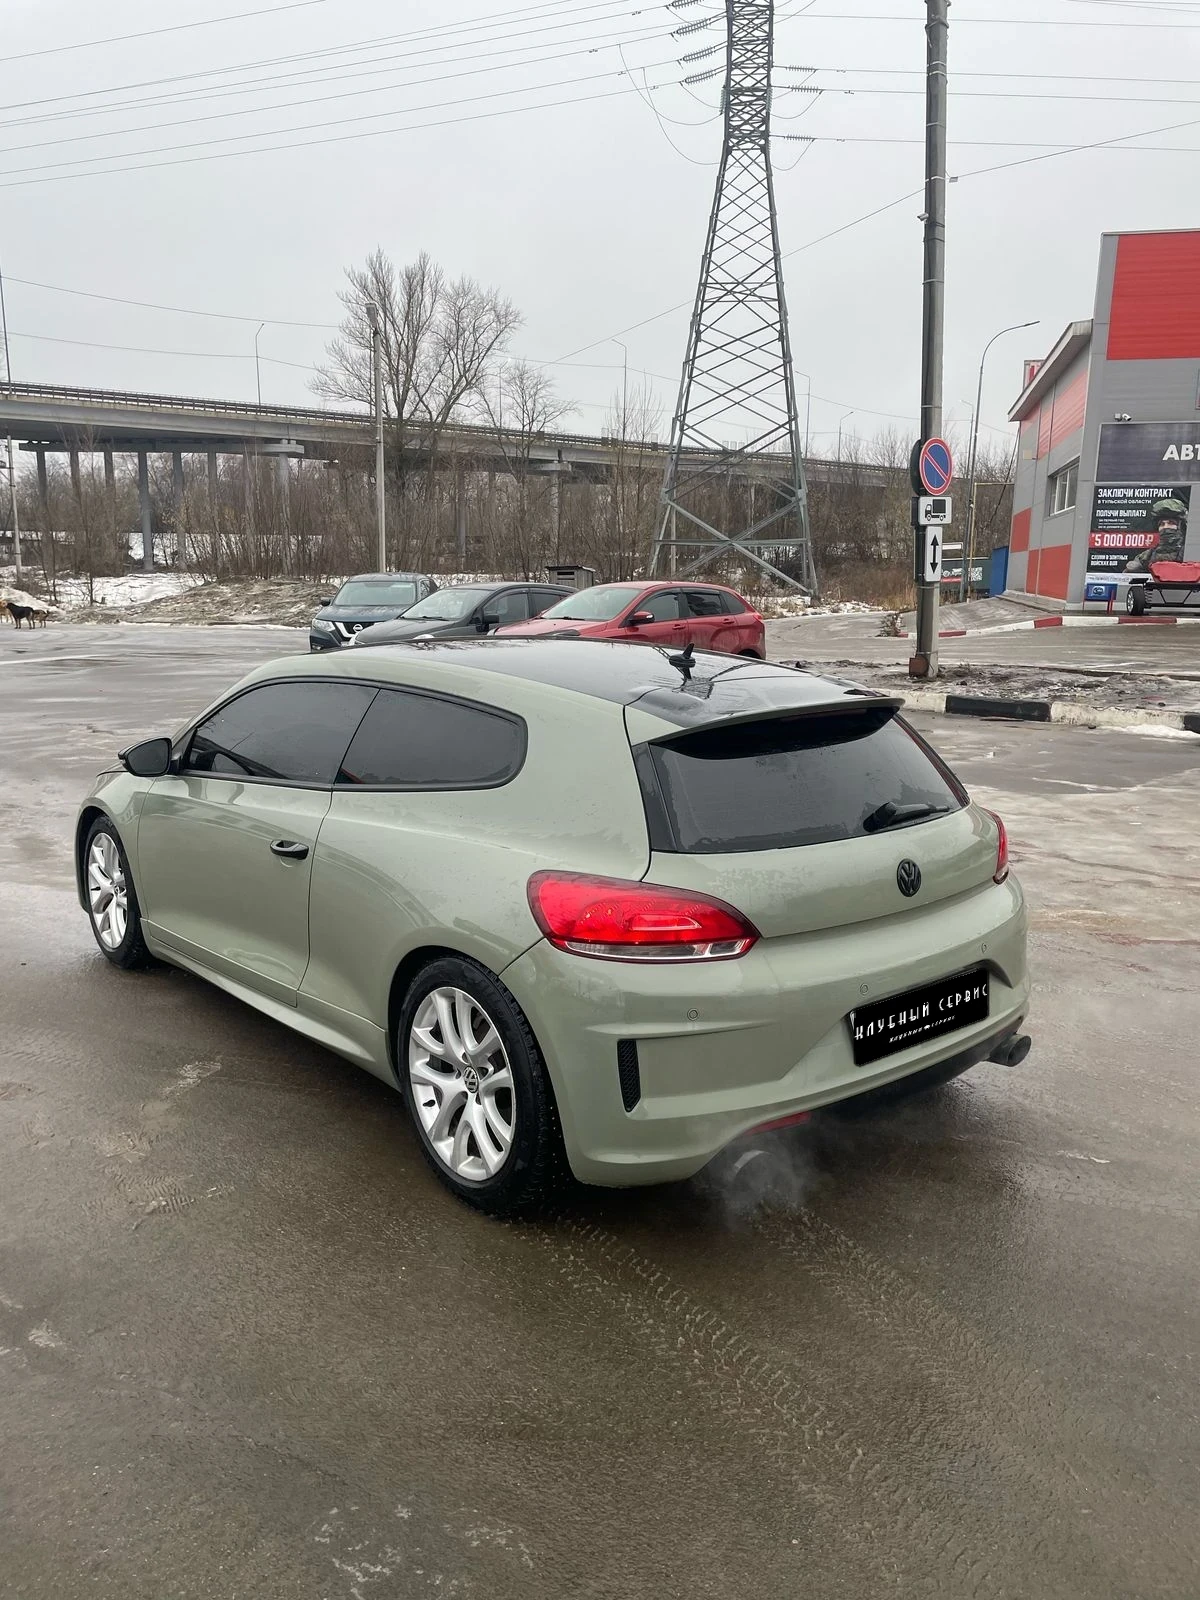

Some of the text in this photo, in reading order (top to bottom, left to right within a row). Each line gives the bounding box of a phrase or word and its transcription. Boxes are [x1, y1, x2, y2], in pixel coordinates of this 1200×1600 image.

[1098, 488, 1173, 498] ЗАКЛЮЧИ КОНТРАКТ
[1096, 509, 1147, 517] ПОЛУЧИ ВЫПЛАТУ
[1095, 533, 1102, 547] 5
[1103, 533, 1123, 547] 000
